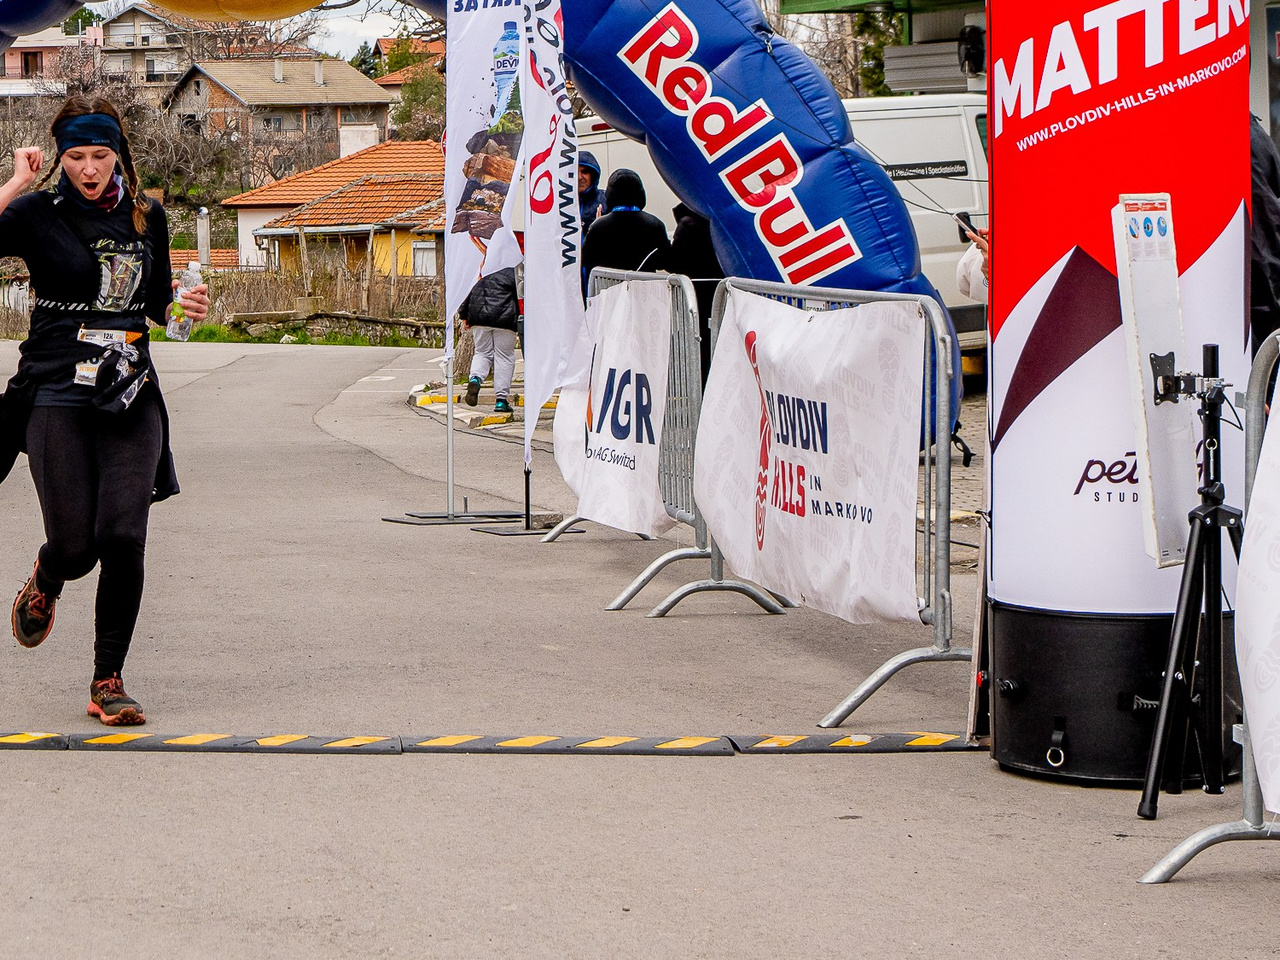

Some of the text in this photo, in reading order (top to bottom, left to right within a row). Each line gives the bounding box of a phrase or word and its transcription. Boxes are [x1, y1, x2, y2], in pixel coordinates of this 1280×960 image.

[618, 2, 863, 286] Red Bull
[1016, 43, 1247, 152] WWW.PLOVDIV-HILLS-IN-MARKOVO.COM
